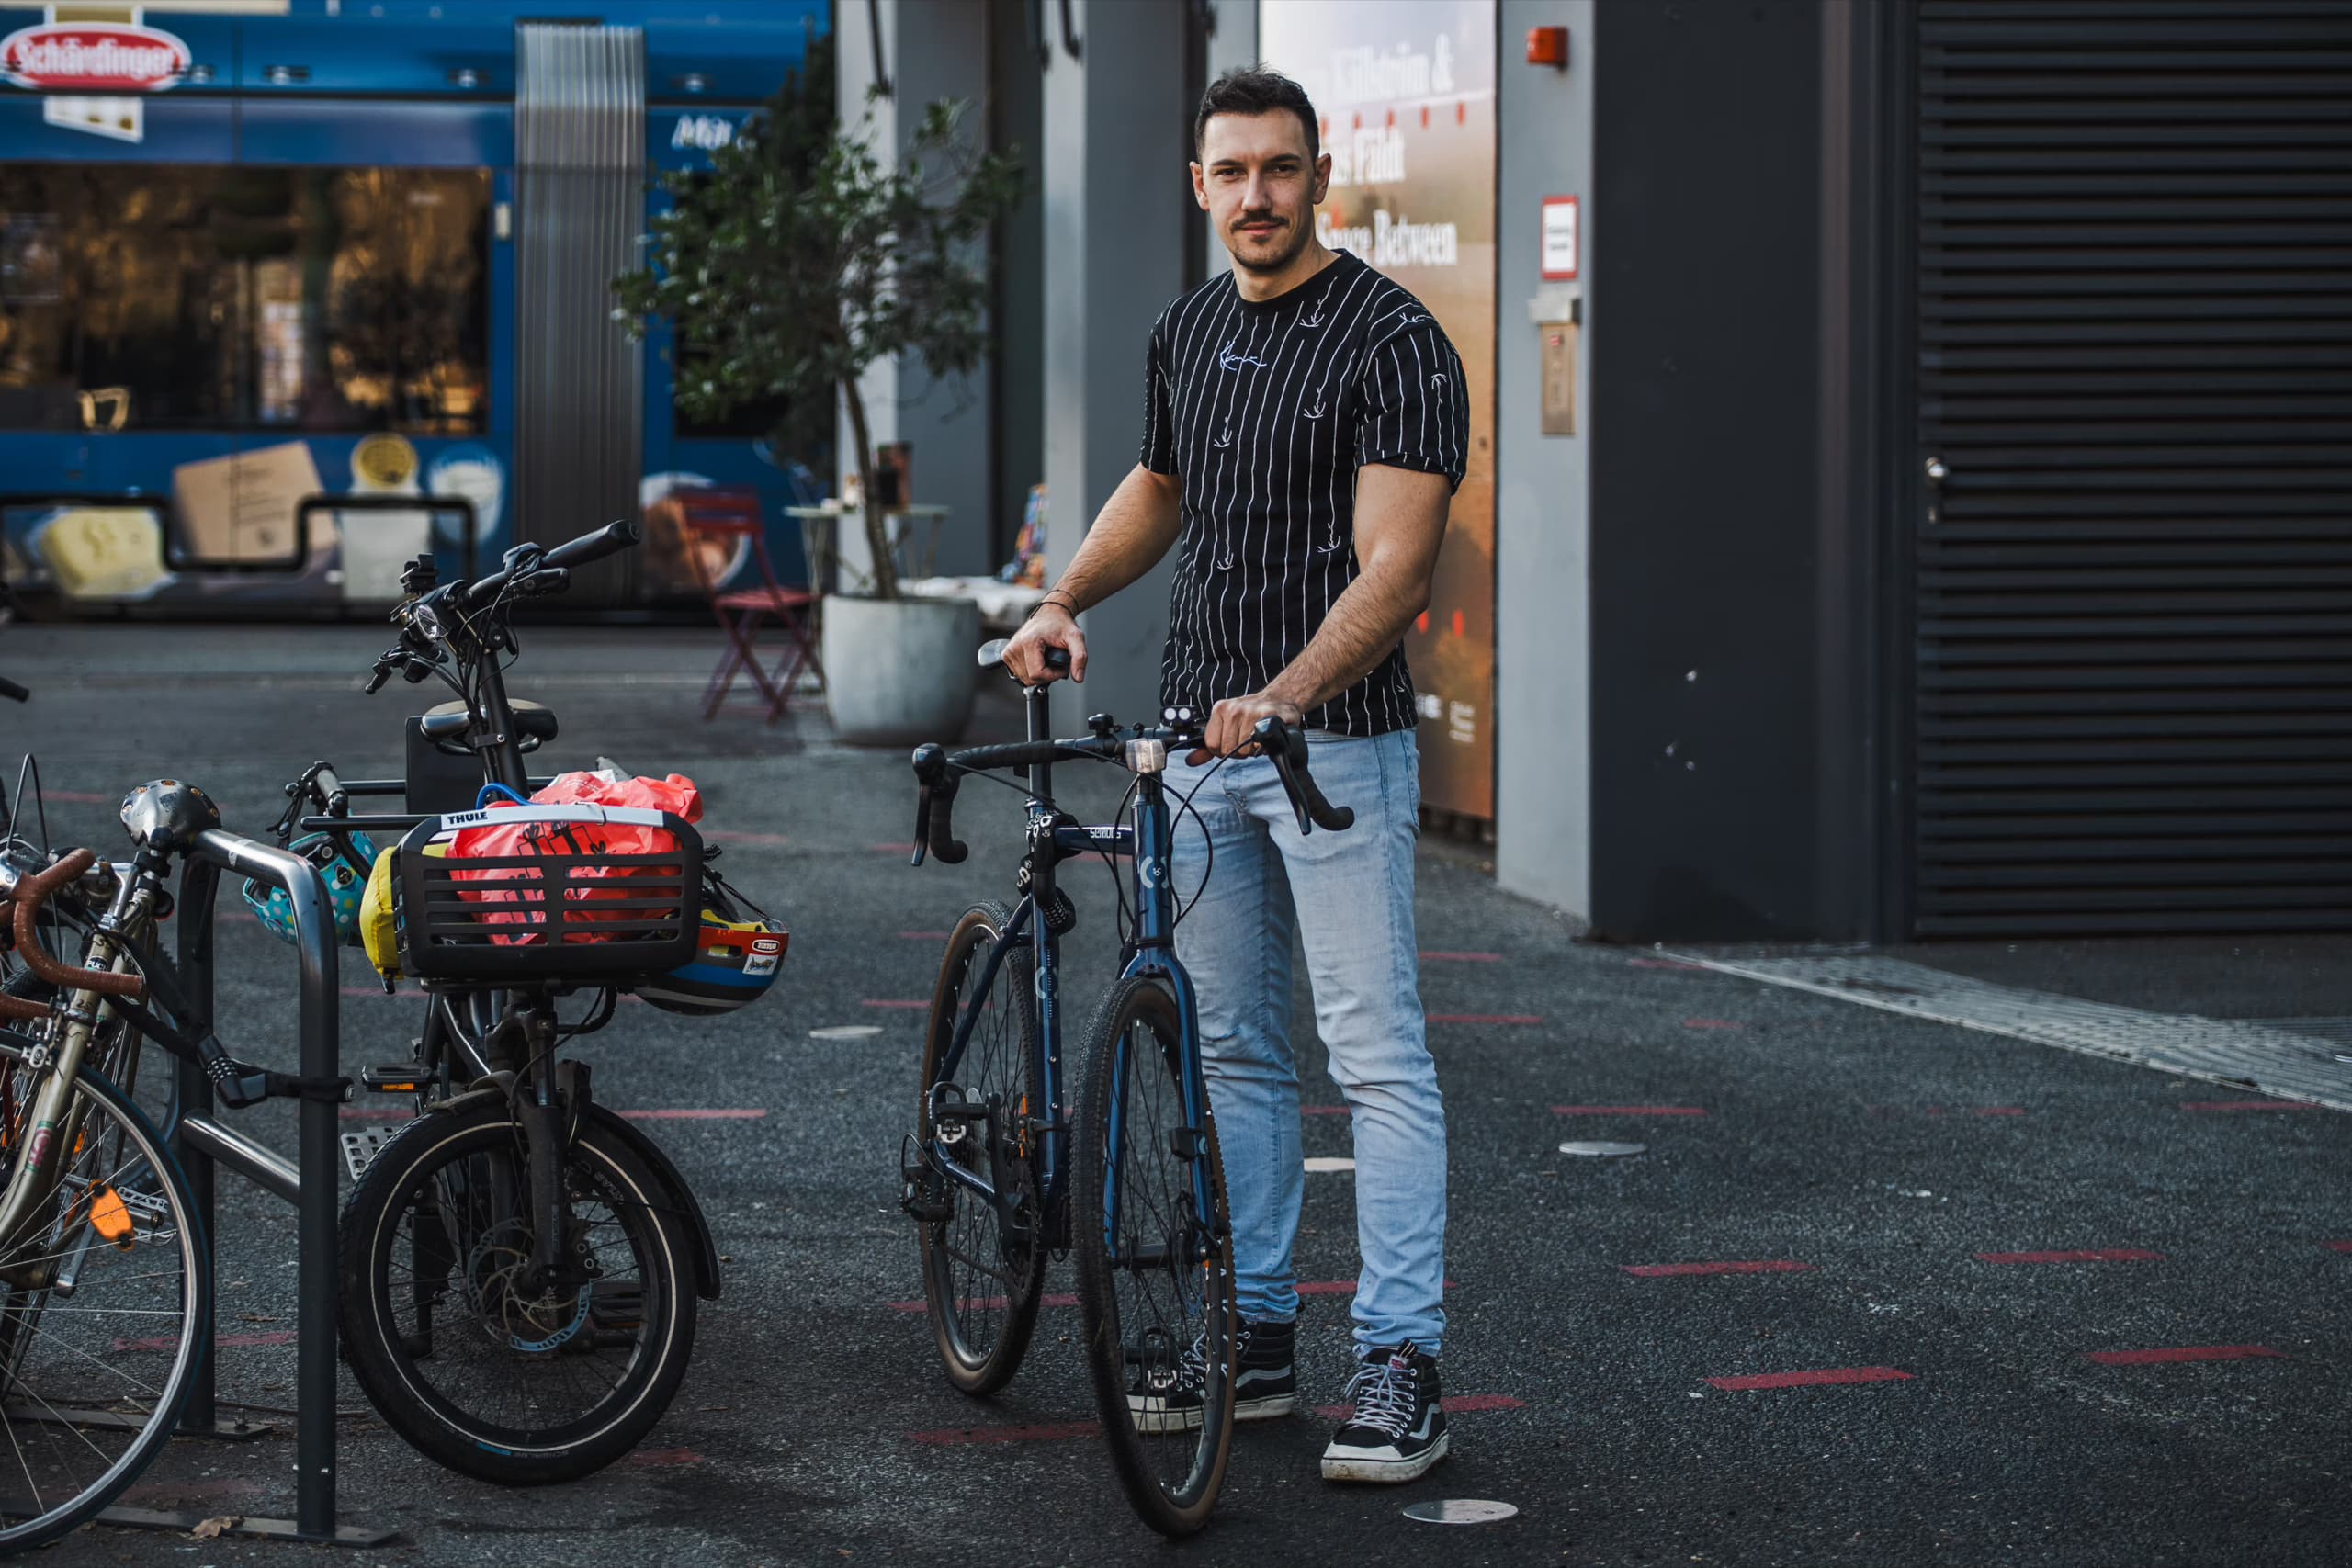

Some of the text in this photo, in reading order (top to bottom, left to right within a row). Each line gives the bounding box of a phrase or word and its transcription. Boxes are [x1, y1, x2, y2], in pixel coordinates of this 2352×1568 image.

[16, 36, 175, 80] Schärdinger
[1374, 209, 1458, 265] Between
[447, 812, 488, 824] THULE
